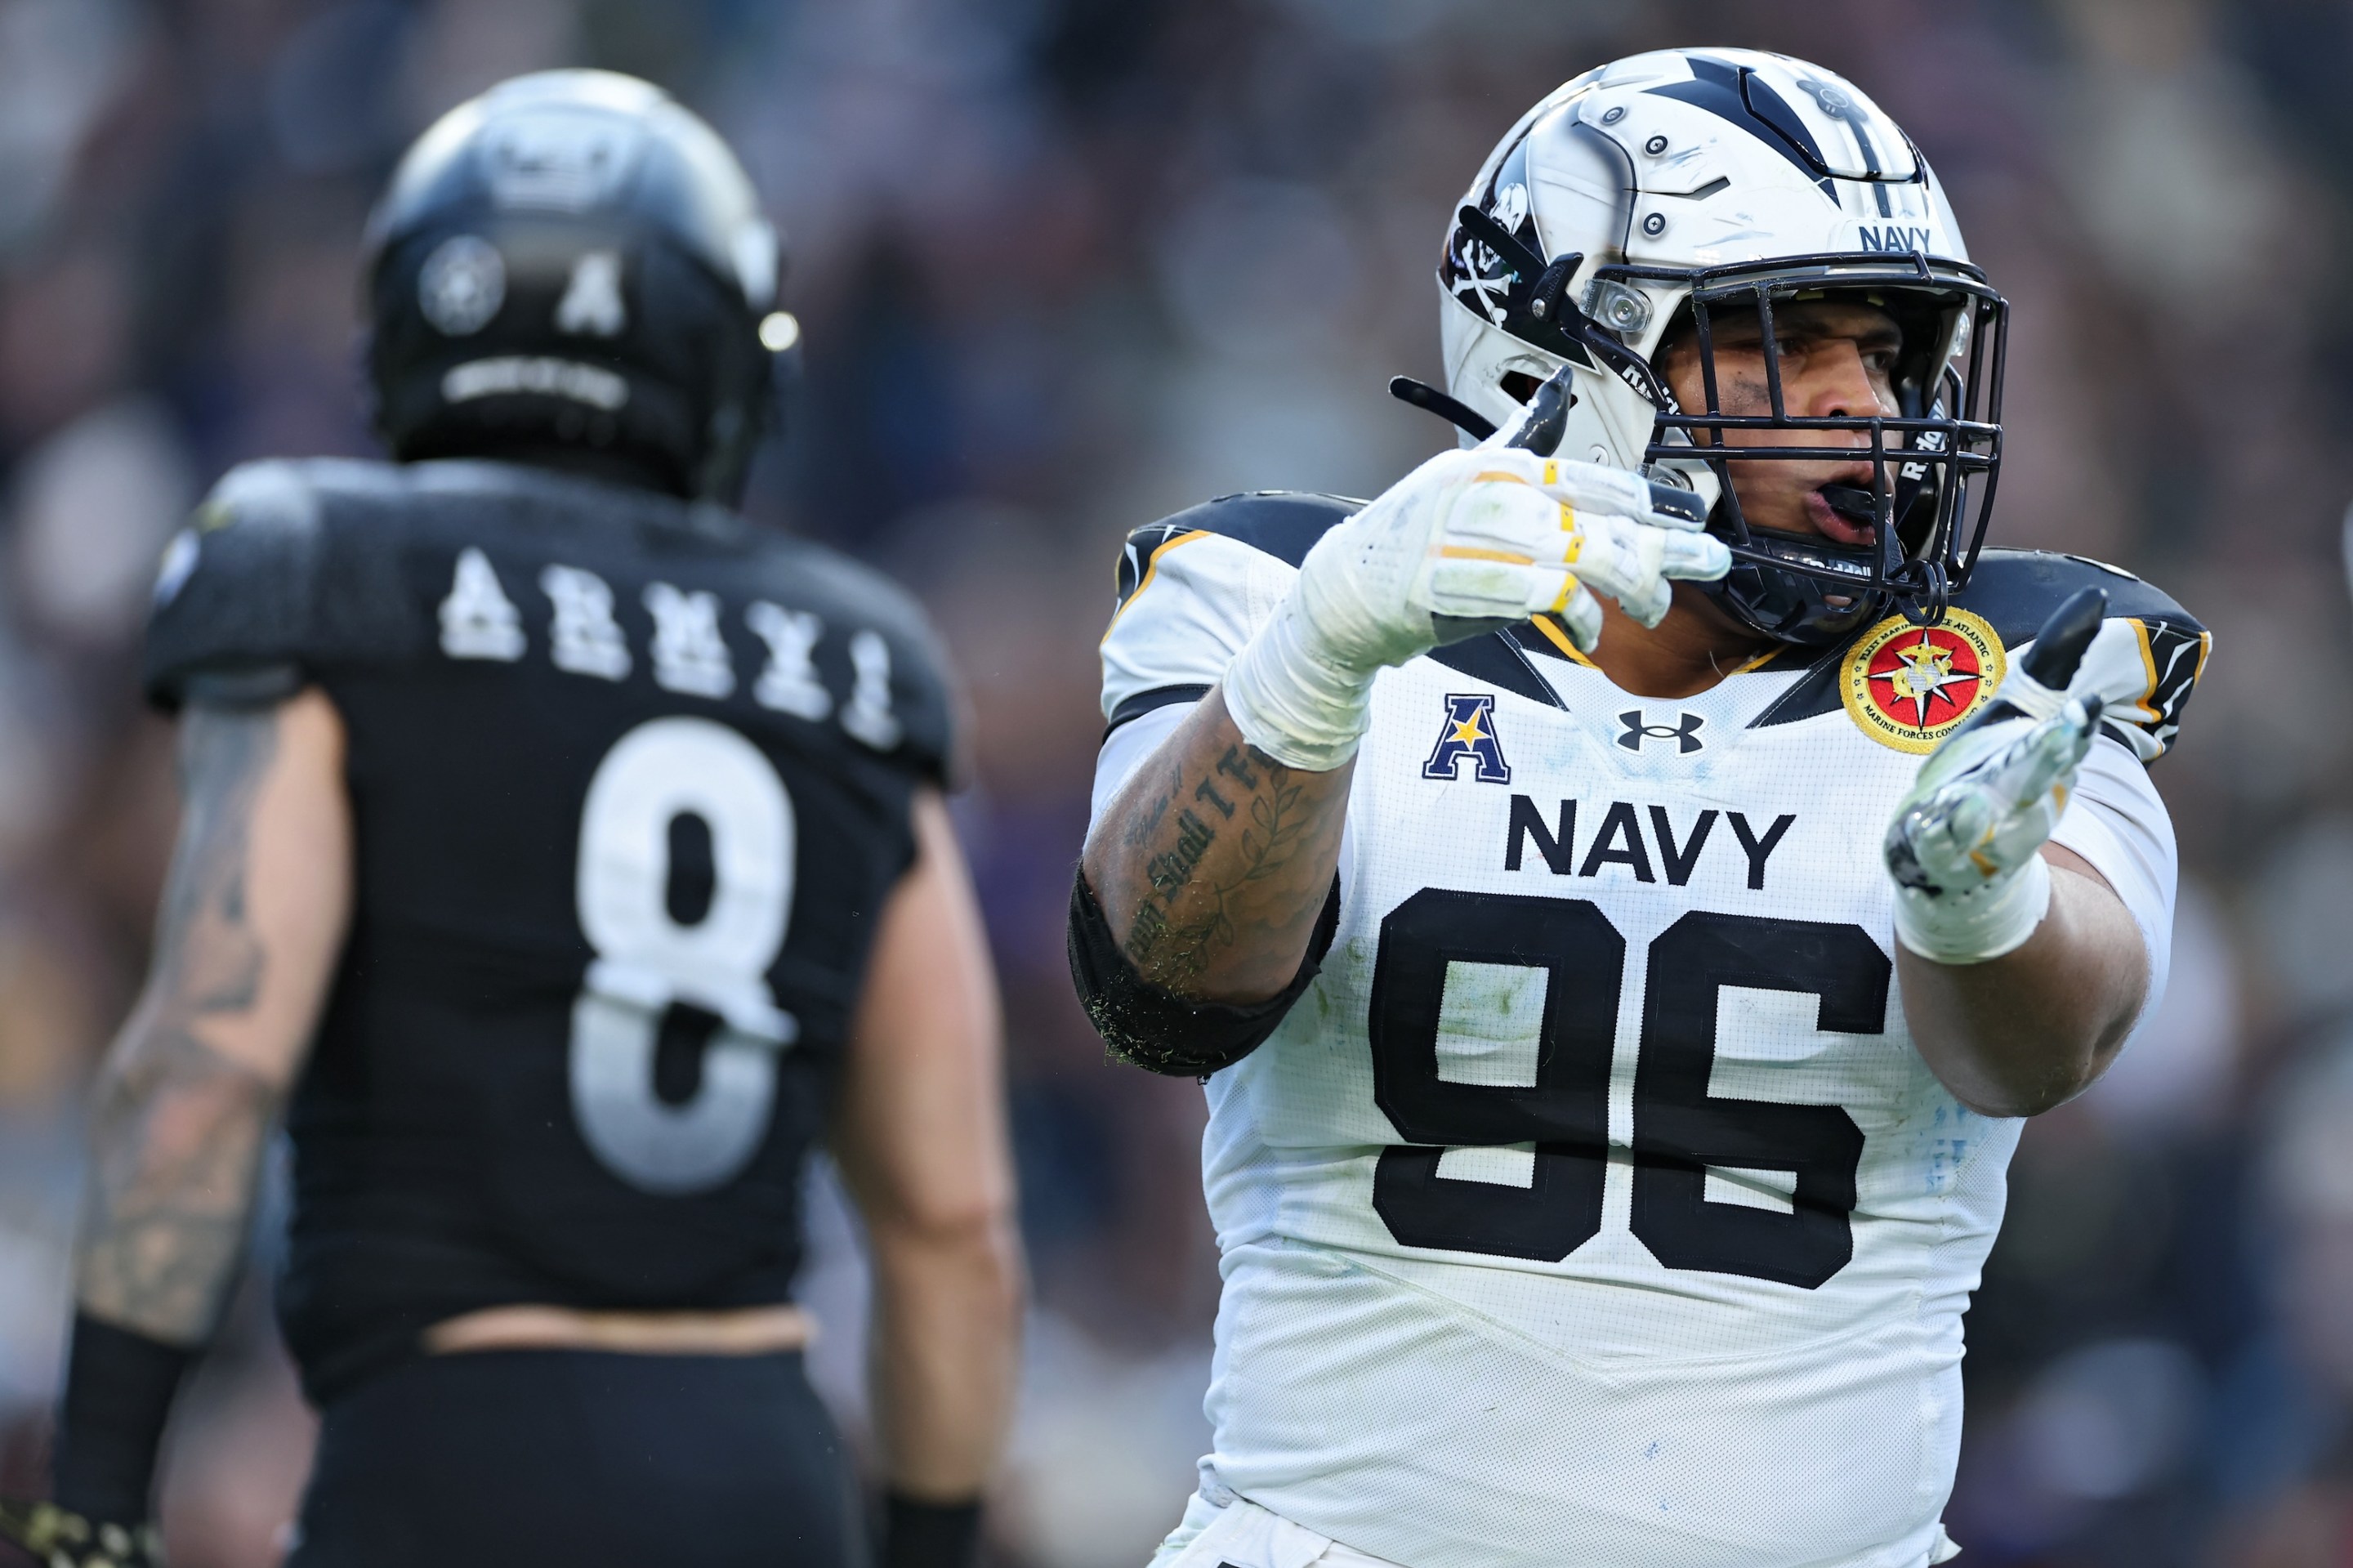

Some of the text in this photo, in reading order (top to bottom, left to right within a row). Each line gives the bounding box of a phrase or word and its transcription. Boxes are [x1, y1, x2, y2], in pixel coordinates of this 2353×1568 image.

[1859, 226, 1930, 252] NAVY
[1859, 639, 1880, 661] FLEET
[1880, 623, 1912, 641] MARIN
[1953, 622, 1989, 658] ATLANTIC
[1863, 704, 1896, 734] MARINE
[1897, 728, 1934, 740] FORCES
[1504, 794, 1797, 890] NAVY
[571, 716, 798, 1195] 8
[1369, 887, 1892, 1290] 96
